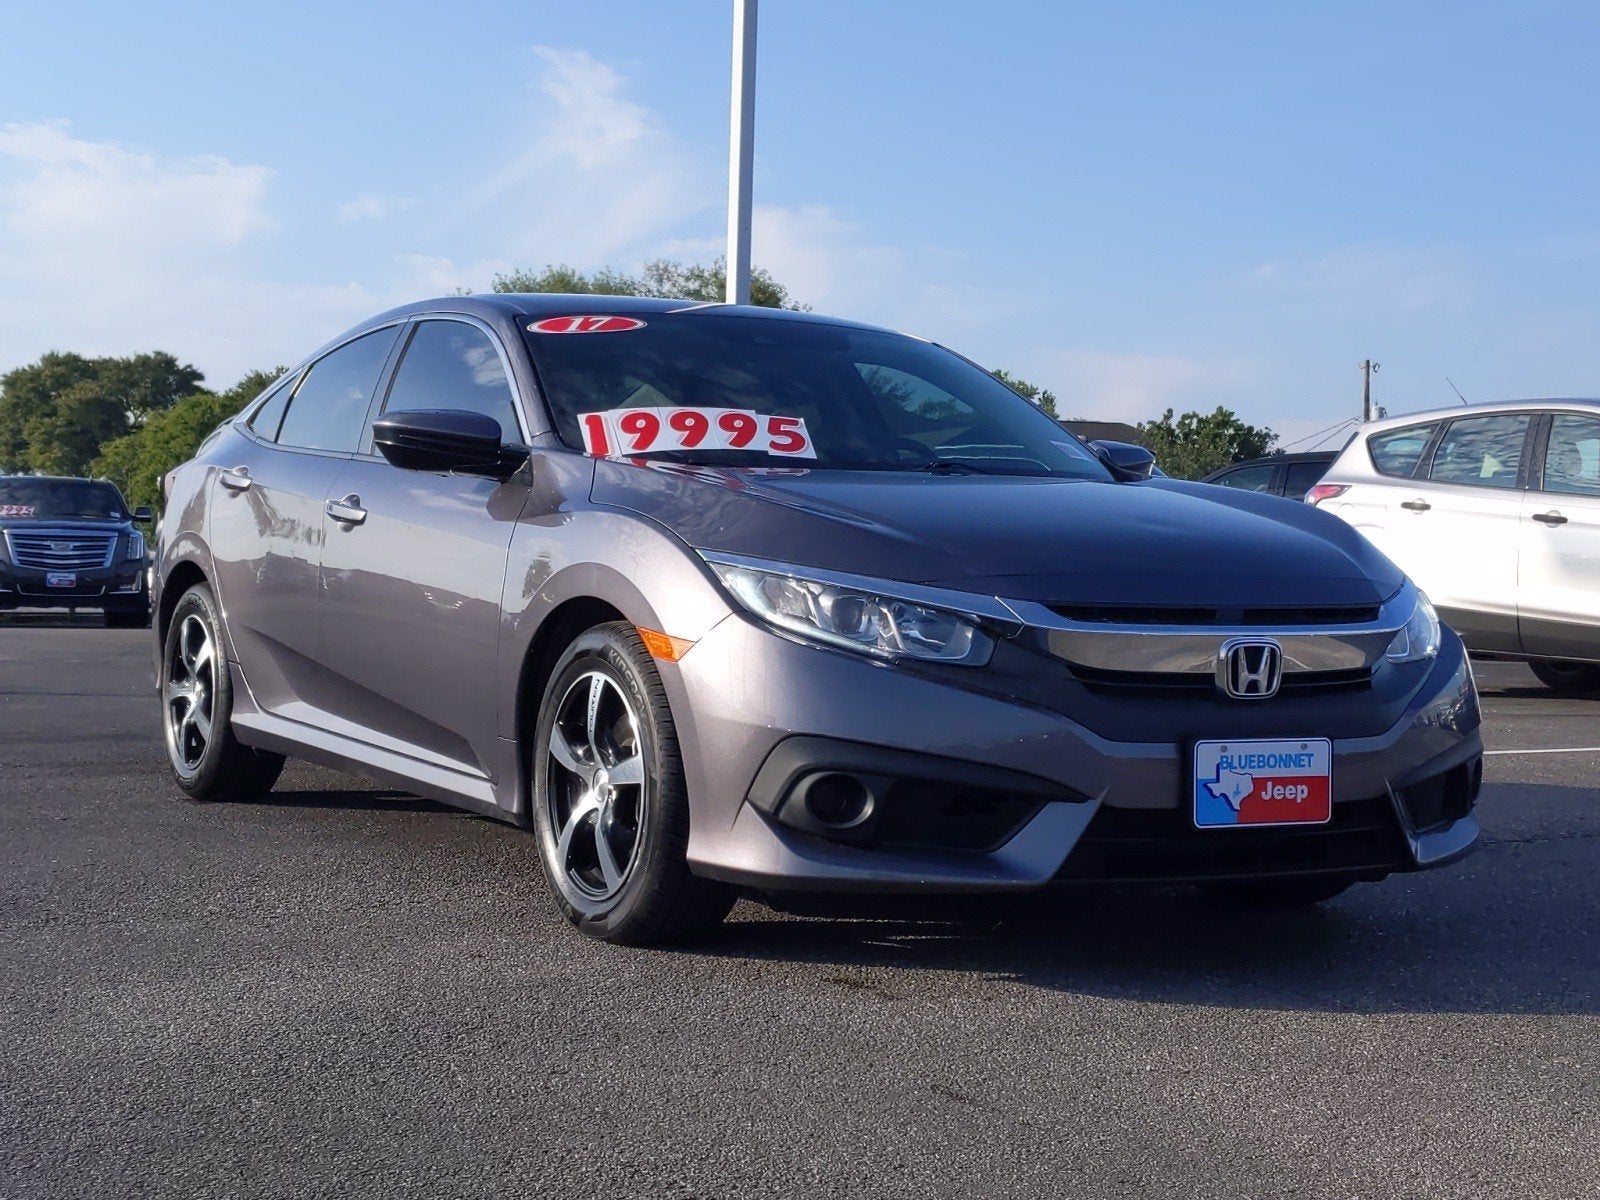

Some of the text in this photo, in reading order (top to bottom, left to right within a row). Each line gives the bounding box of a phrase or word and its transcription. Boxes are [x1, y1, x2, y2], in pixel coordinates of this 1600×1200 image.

[565, 317, 613, 331] 17
[585, 411, 807, 455] 19995
[1219, 753, 1315, 770] BLUEBONNET
[1261, 781, 1309, 803] Jeep
